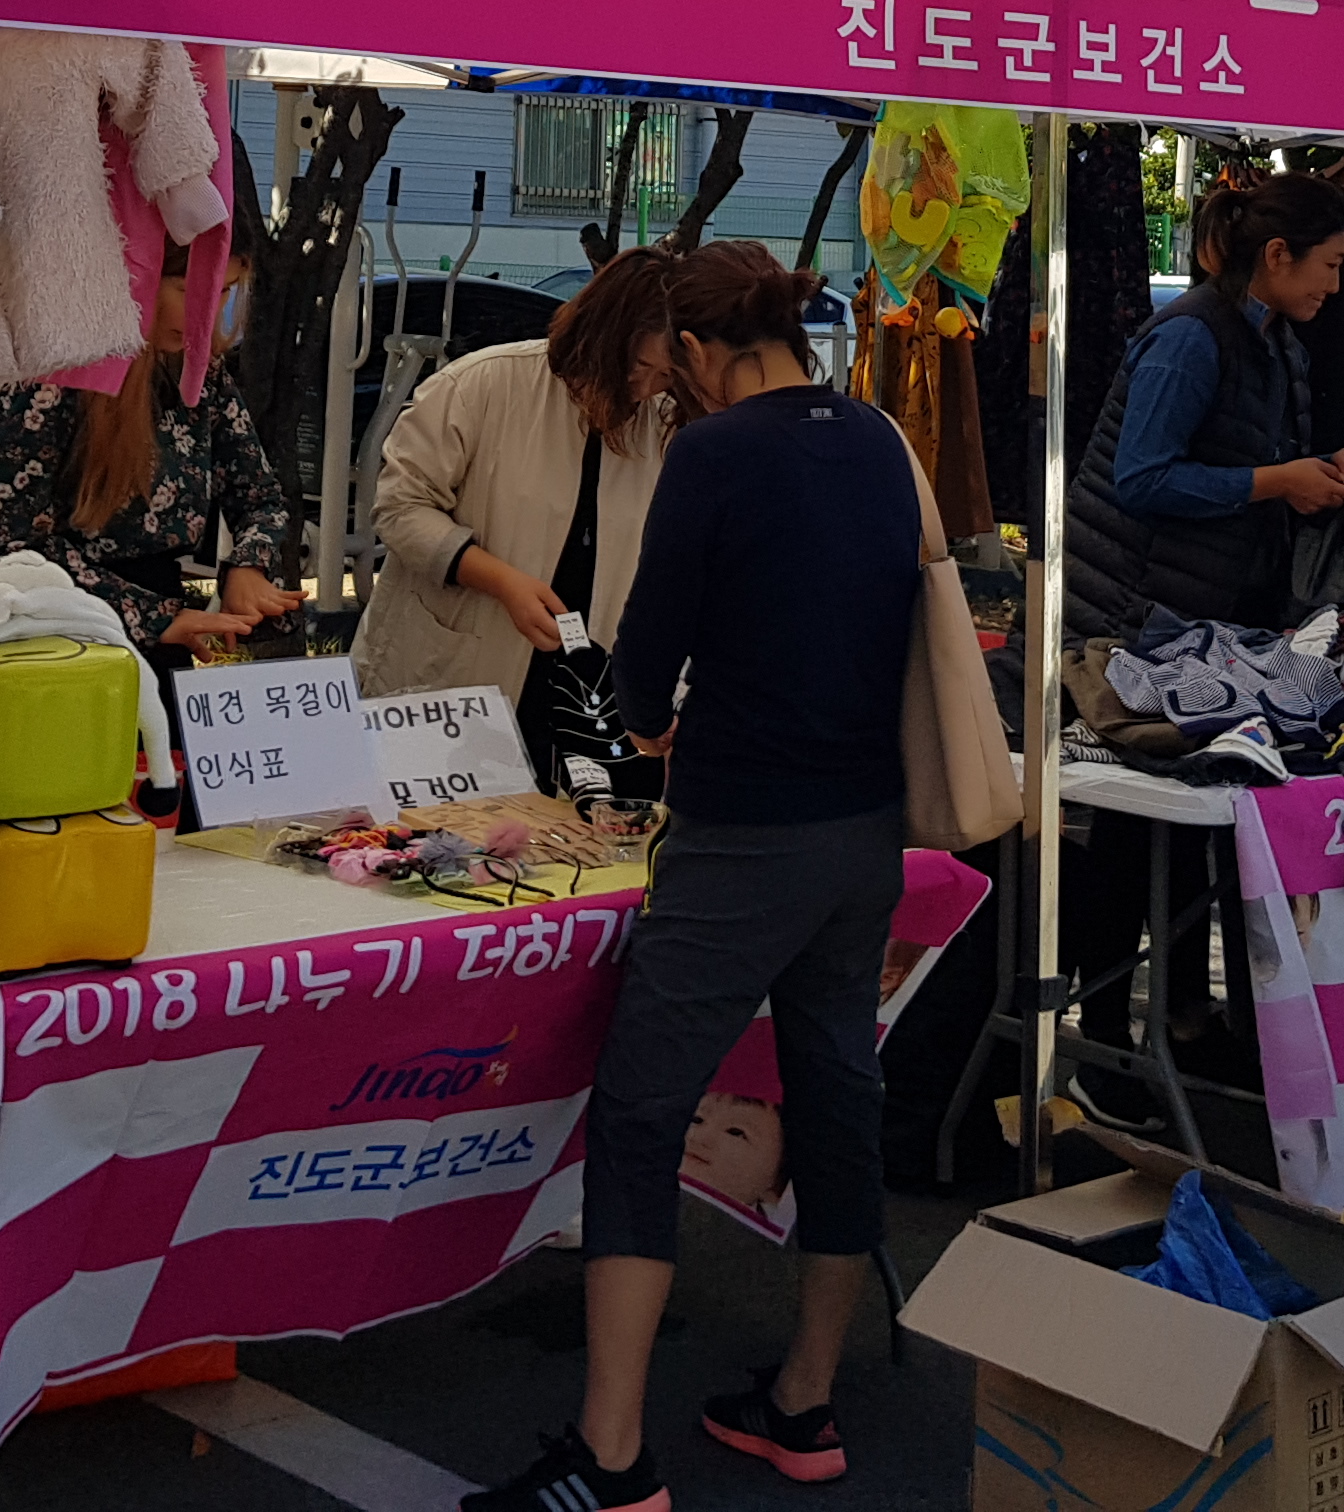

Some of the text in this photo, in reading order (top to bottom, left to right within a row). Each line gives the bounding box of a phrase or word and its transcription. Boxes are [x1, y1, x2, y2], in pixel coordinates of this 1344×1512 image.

[186, 680, 351, 727] 애견 목걸이
[196, 747, 289, 790] 인식표
[15, 906, 635, 1057] 2018 나누기 더하기
[248, 1125, 536, 1201] 진도군보건소
